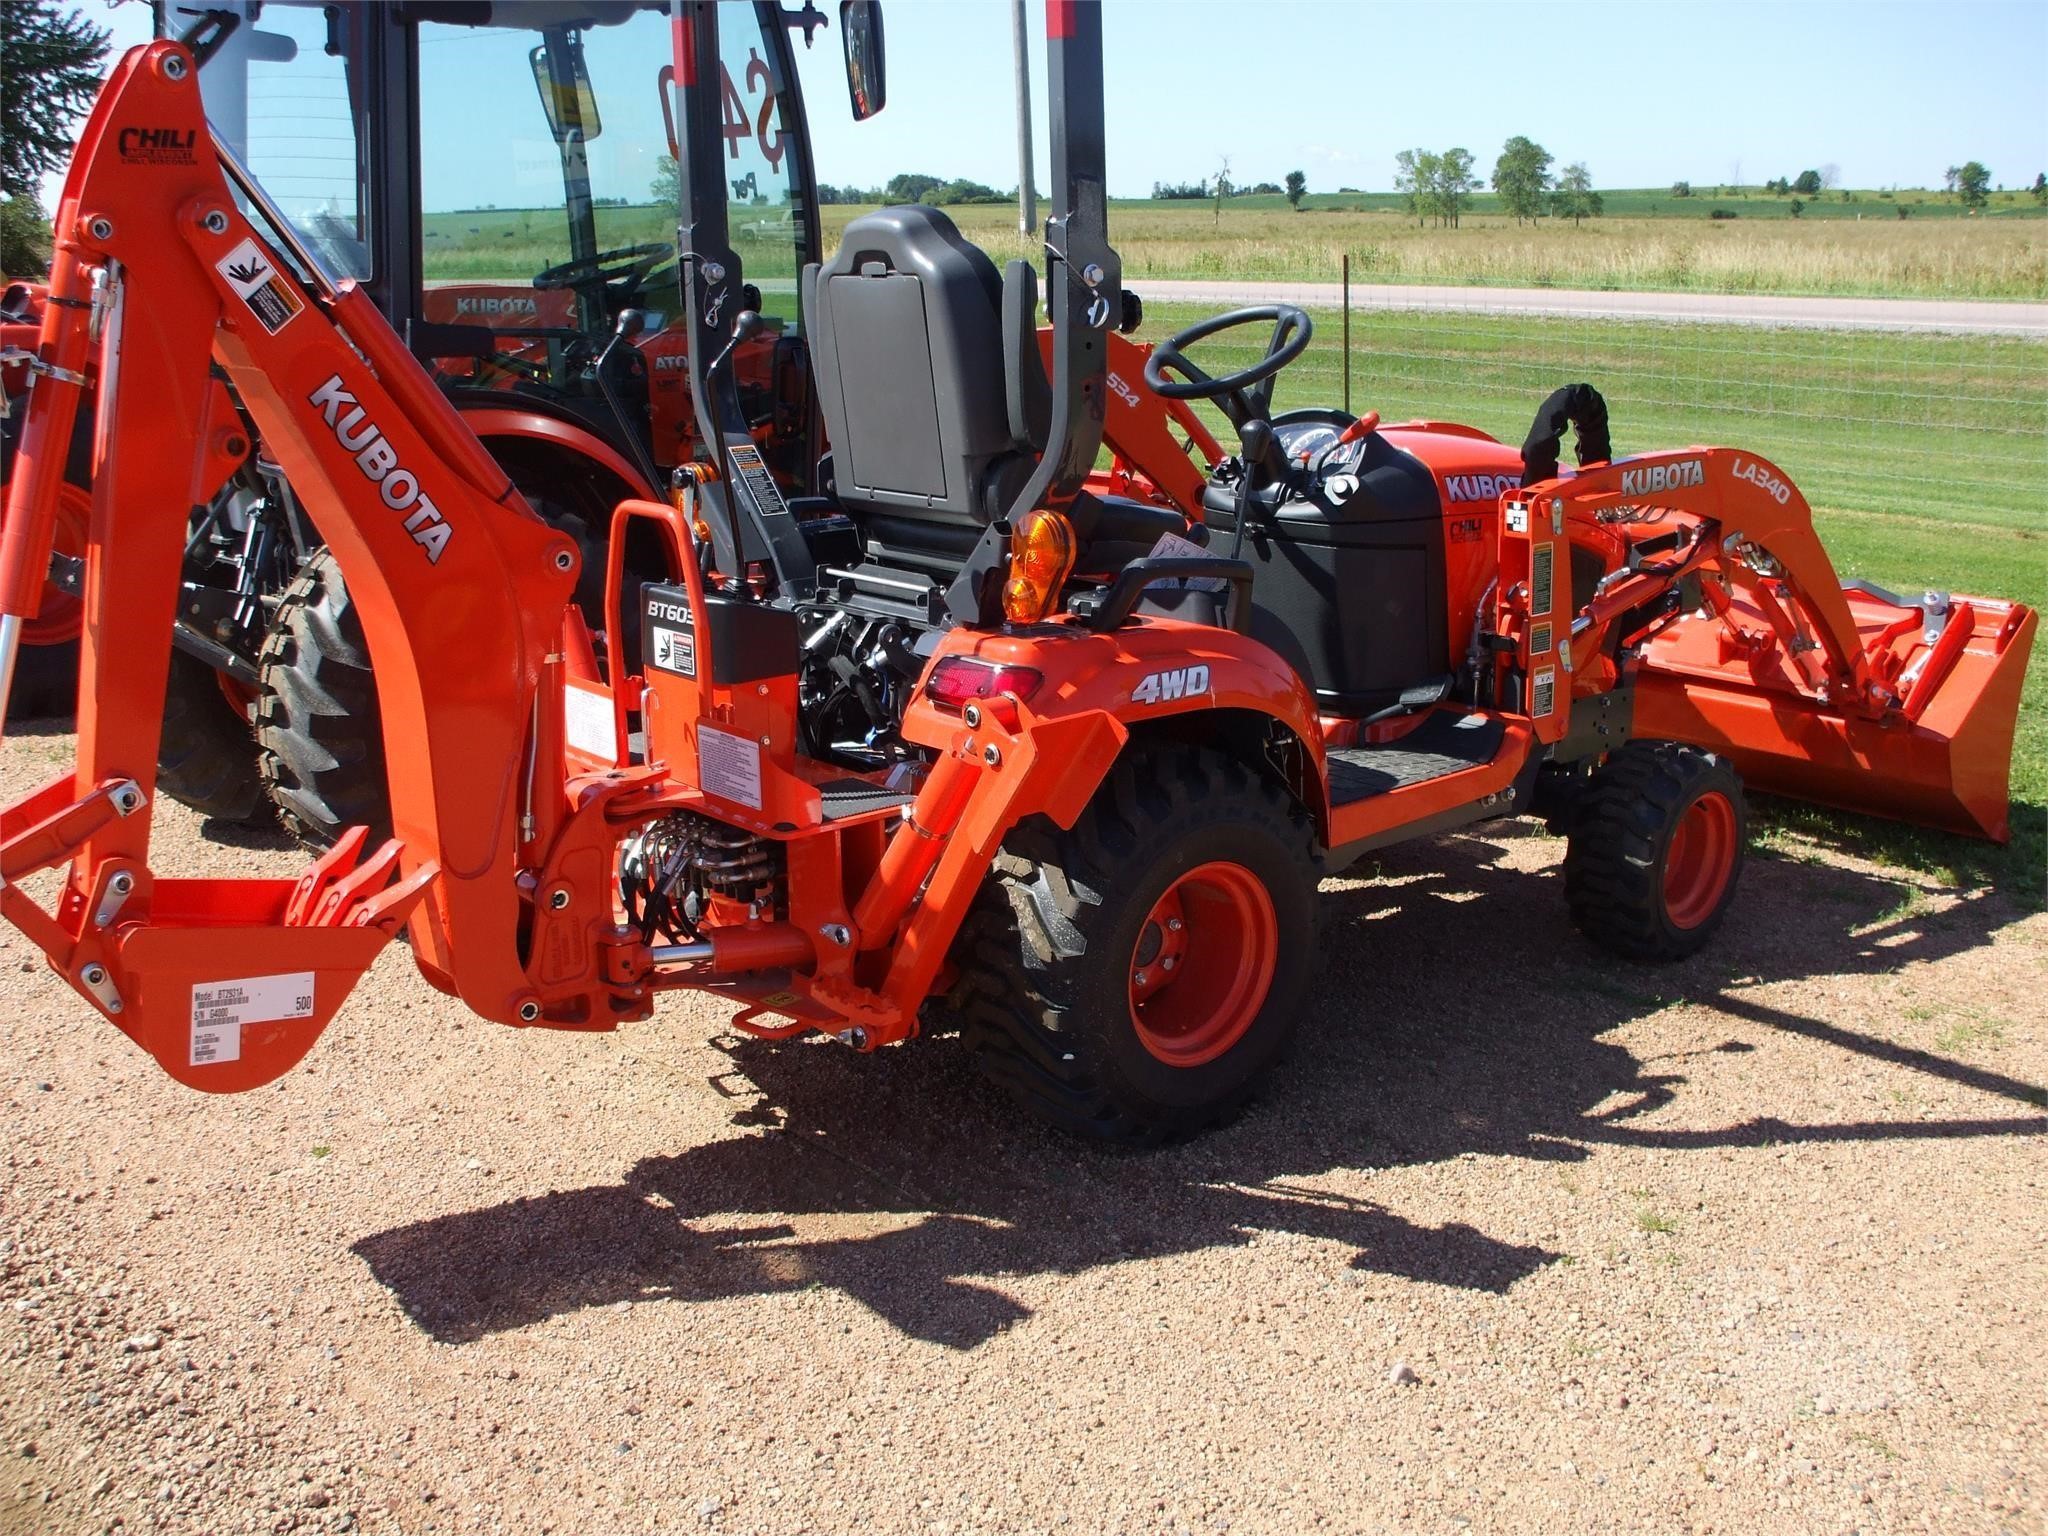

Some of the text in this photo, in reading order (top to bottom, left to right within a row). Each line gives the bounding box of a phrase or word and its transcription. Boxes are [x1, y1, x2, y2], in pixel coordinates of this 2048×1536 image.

[119, 127, 196, 157] CHILI
[457, 297, 537, 314] KUBOTA
[308, 373, 453, 566] KUBOTA
[1622, 458, 1791, 505] KUBOTA LA340
[1444, 474, 1521, 502] KUBOT
[1132, 664, 1210, 705] 4WD
[195, 991, 213, 1001] Model
[296, 996, 311, 1010] 500
